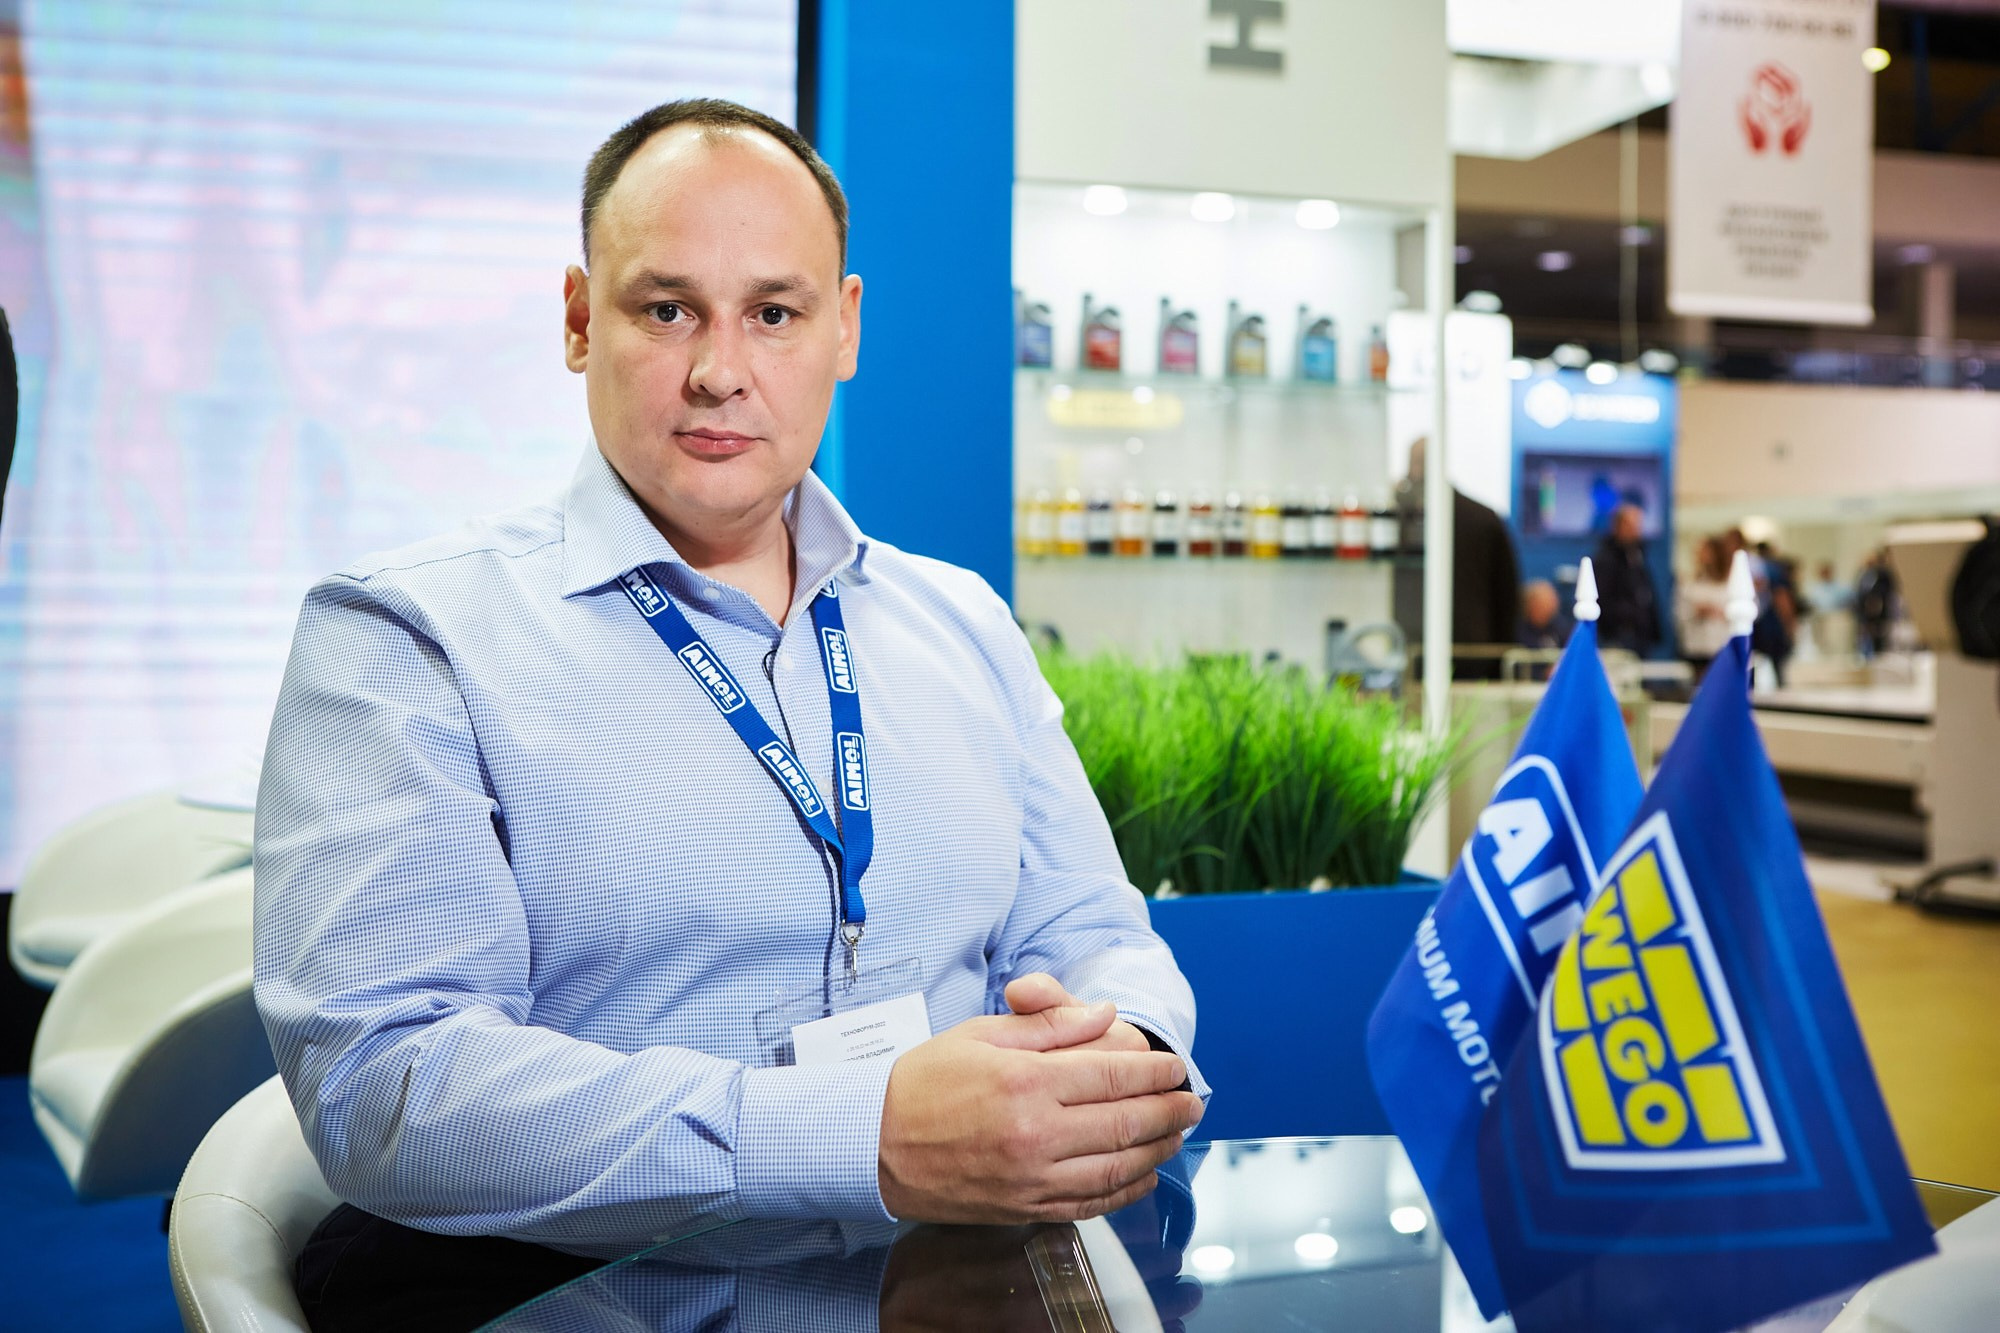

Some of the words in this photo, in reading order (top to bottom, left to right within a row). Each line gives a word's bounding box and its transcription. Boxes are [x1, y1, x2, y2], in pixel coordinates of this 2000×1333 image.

[622, 569, 660, 613] MOL
[683, 648, 737, 709] AIMOL
[828, 632, 851, 690] AIMOL
[763, 748, 818, 815] AIMOL
[843, 736, 865, 808] AIMOL
[1581, 884, 1688, 1147] WEGO
